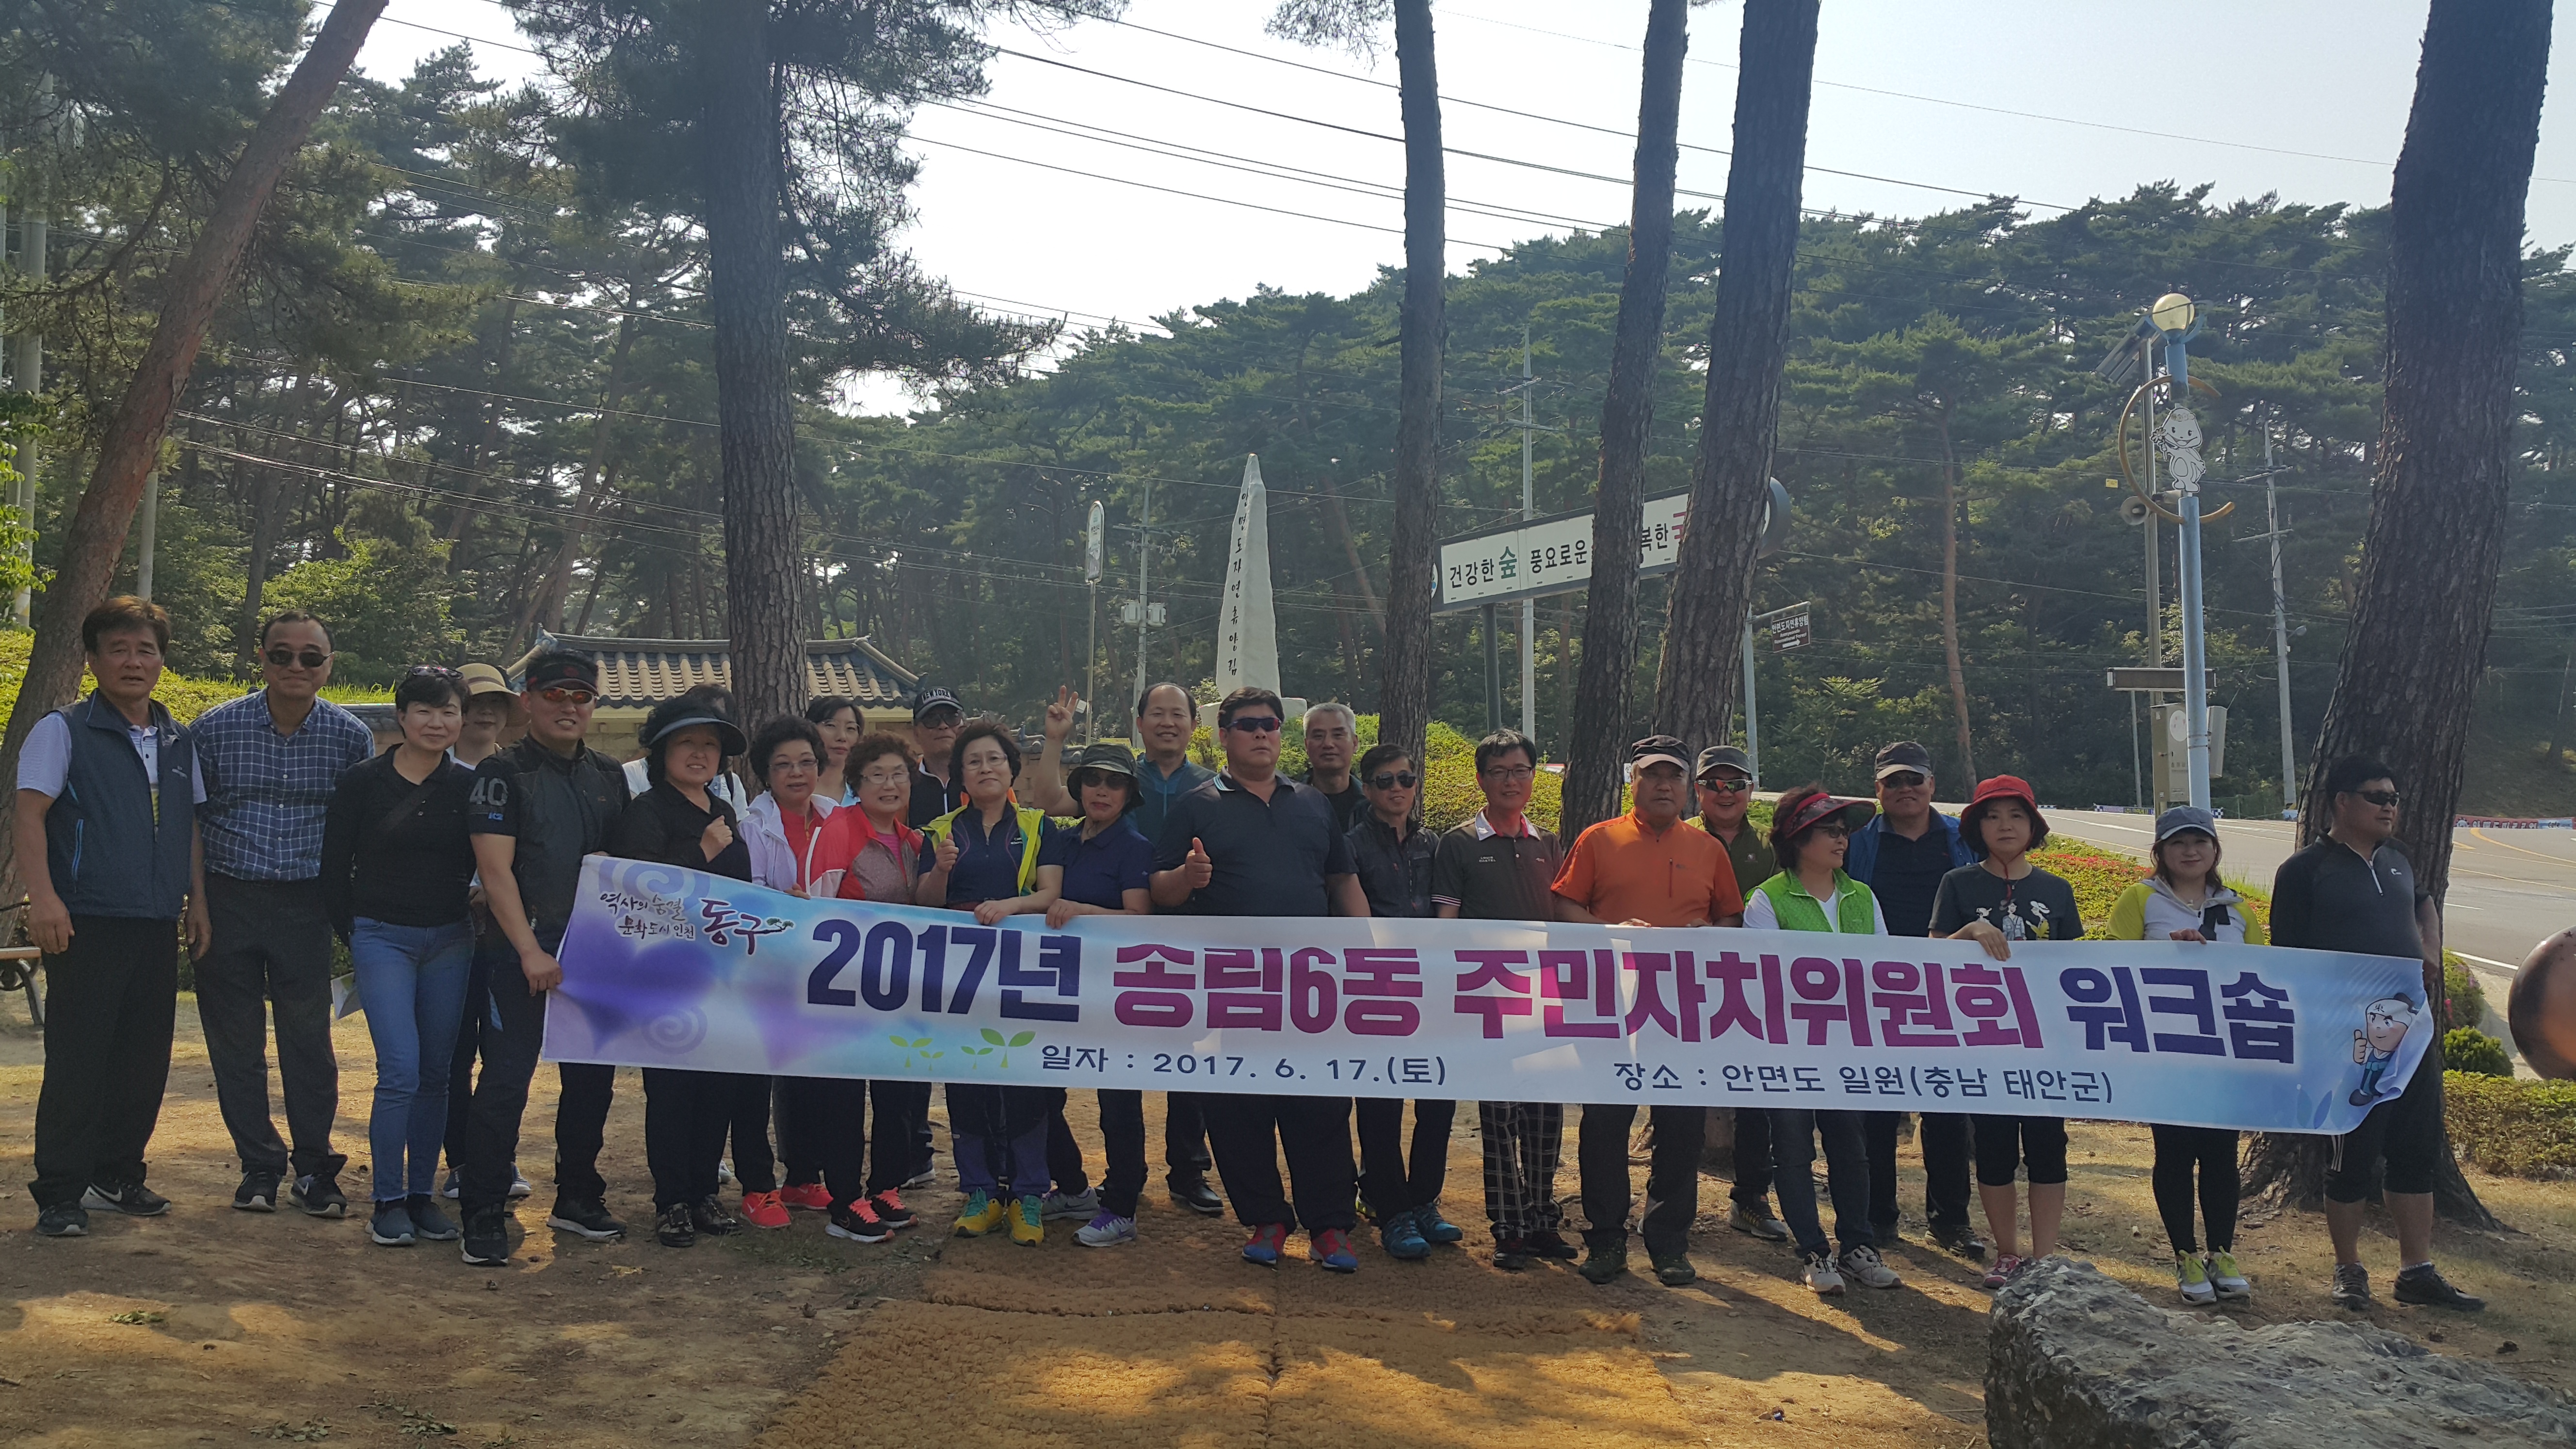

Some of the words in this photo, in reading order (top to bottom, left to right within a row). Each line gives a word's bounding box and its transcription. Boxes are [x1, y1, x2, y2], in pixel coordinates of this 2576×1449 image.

[1449, 558, 1494, 588] 건강한
[1498, 546, 1517, 579] 숲
[1530, 539, 1587, 573] 풍요로운
[1642, 523, 1669, 551] 복한
[1227, 492, 1249, 676] 안면도자연휴양림
[1771, 615, 1808, 634] 안면도자연휴양림
[922, 690, 934, 701] NEW
[933, 688, 950, 698] YORK
[469, 777, 508, 806] 40
[600, 892, 647, 915] 역사의
[652, 894, 686, 921] 숨결
[618, 915, 670, 939] 문화도시
[673, 923, 694, 939] 인천
[701, 899, 762, 955] 동구
[807, 919, 1081, 1022] 2017년
[1113, 943, 1423, 1037] 송림6동
[1454, 949, 2044, 1049] 주민자치위원회
[2059, 966, 2295, 1064] 워크숍
[1041, 1044, 1108, 1073] 일자
[1153, 1053, 1256, 1077] 2017.
[1275, 1058, 1306, 1079] 6.
[1614, 1062, 1682, 1092] 장소
[1723, 1064, 1825, 1093] 안면도
[1839, 1066, 1987, 1097] 일원(충남
[2004, 1069, 2112, 1104] 태안군)
